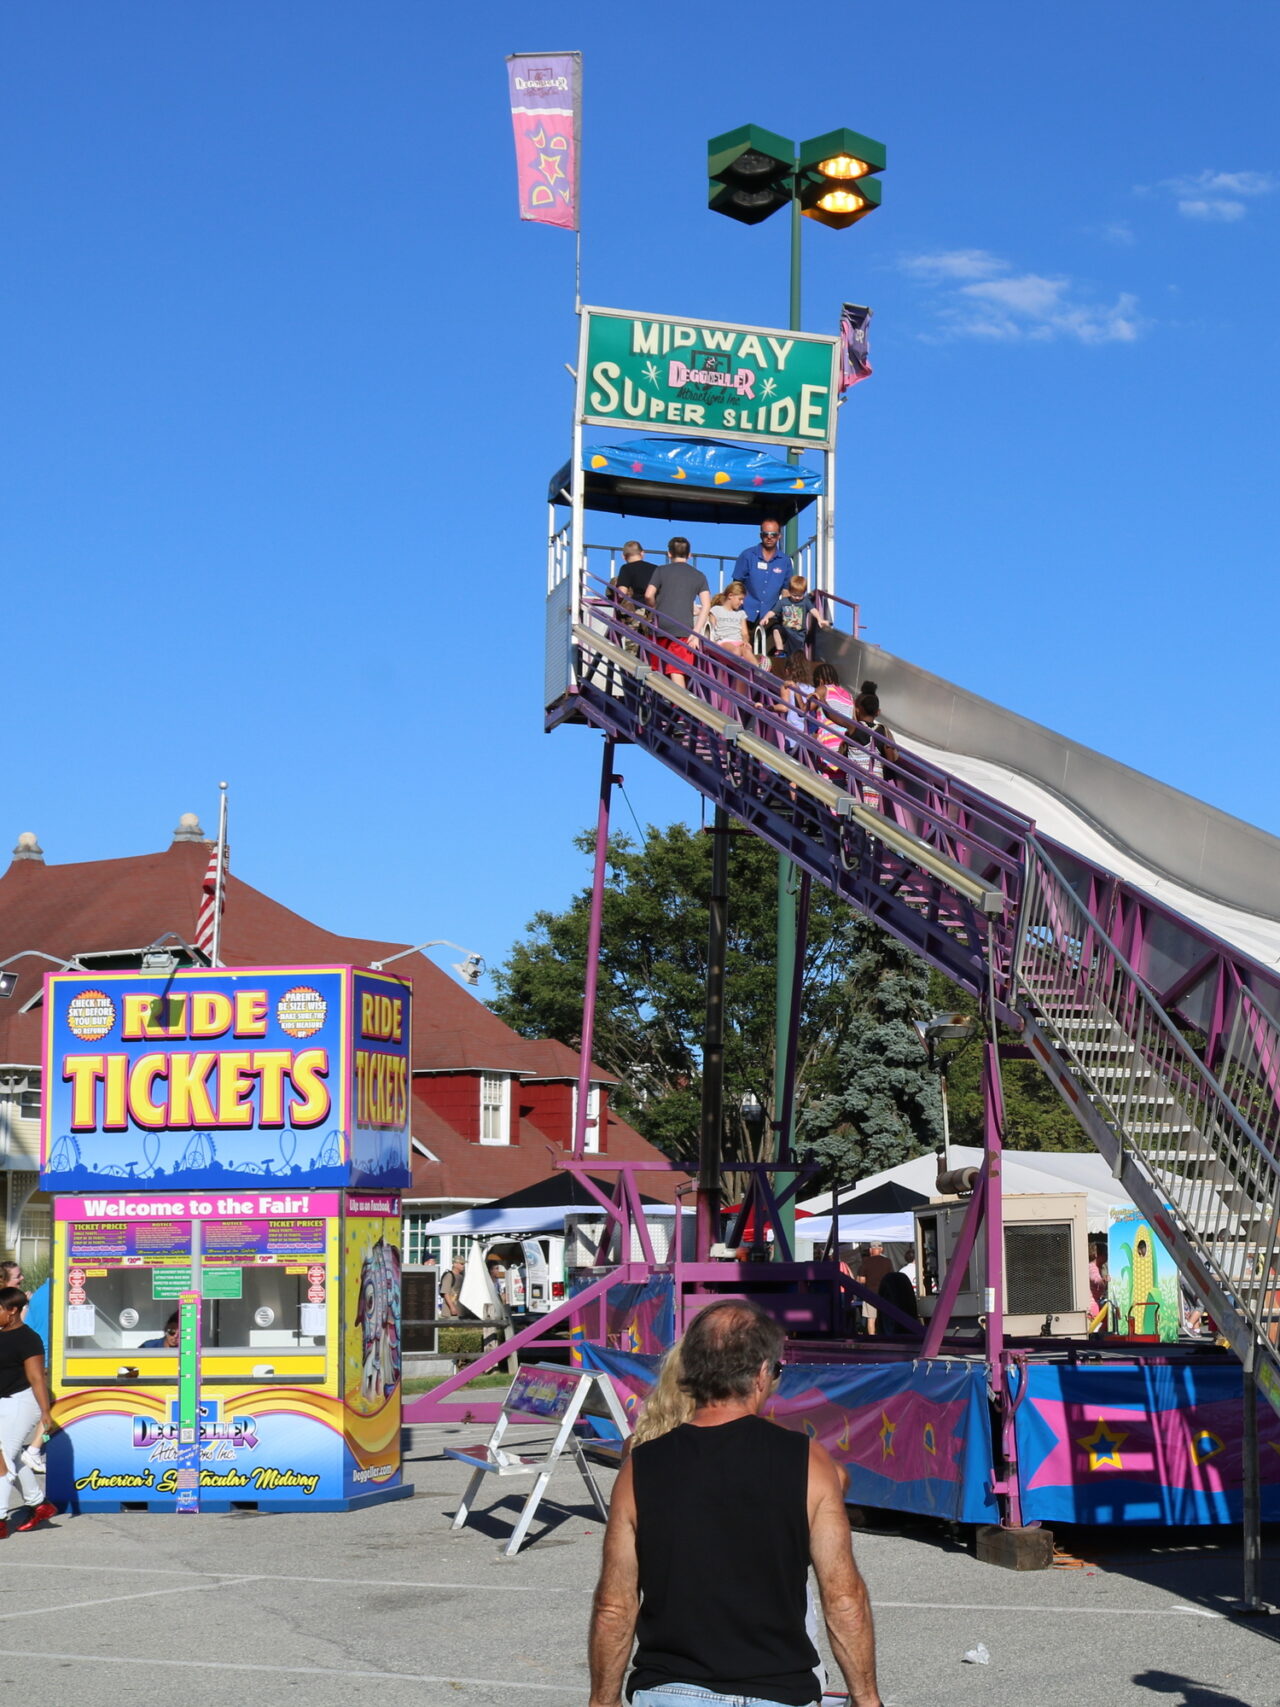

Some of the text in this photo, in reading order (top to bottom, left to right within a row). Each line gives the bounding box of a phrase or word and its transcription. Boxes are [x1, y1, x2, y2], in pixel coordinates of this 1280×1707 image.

[633, 320, 794, 370] MIDWAY
[590, 361, 828, 438] SUPER SLIDE
[71, 999, 111, 1007] CHECK THE
[286, 993, 319, 1001] PARENTS
[75, 1017, 107, 1025] YOU BUY
[86, 1007, 113, 1016] BEFORE
[122, 990, 267, 1040] RIDE
[361, 991, 402, 1042] RIDE
[63, 1049, 330, 1129] TICKETS
[356, 1049, 407, 1130] TICKETS
[85, 1196, 309, 1216] Welcome to the Fair!
[269, 1220, 294, 1228] TICKET
[133, 1415, 258, 1448] DEGELLER
[217, 1445, 236, 1460] Inc.
[75, 1469, 155, 1491] America's
[157, 1469, 249, 1494] Sptacular
[250, 1468, 320, 1494] Midway
